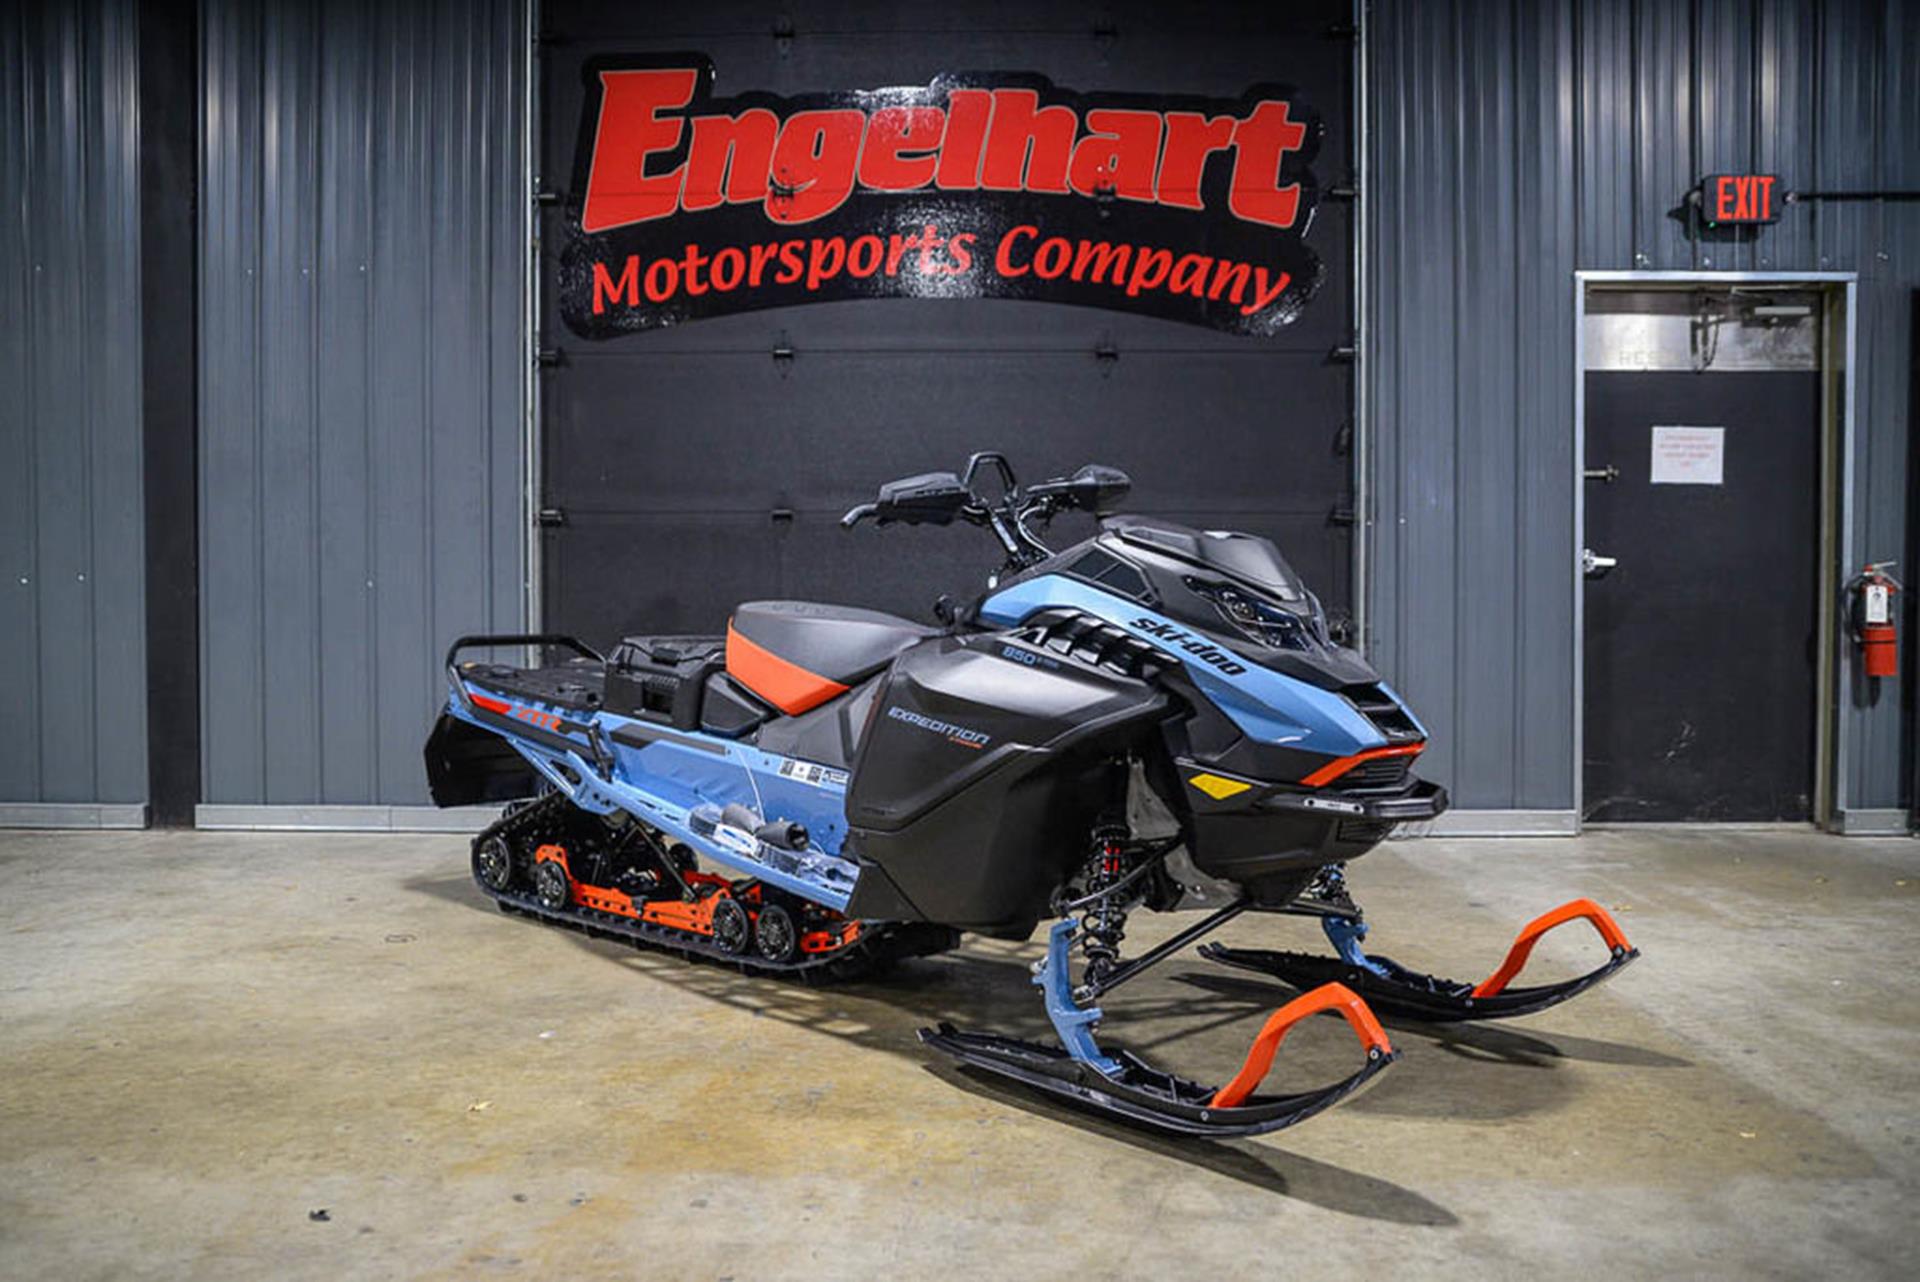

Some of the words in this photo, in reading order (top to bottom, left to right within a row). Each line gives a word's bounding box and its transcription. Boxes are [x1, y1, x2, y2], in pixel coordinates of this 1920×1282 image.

[583, 70, 1307, 232] Engelhart
[1717, 176, 1775, 220] EXIT
[593, 225, 975, 315] Motorsports
[995, 225, 1291, 316] Company
